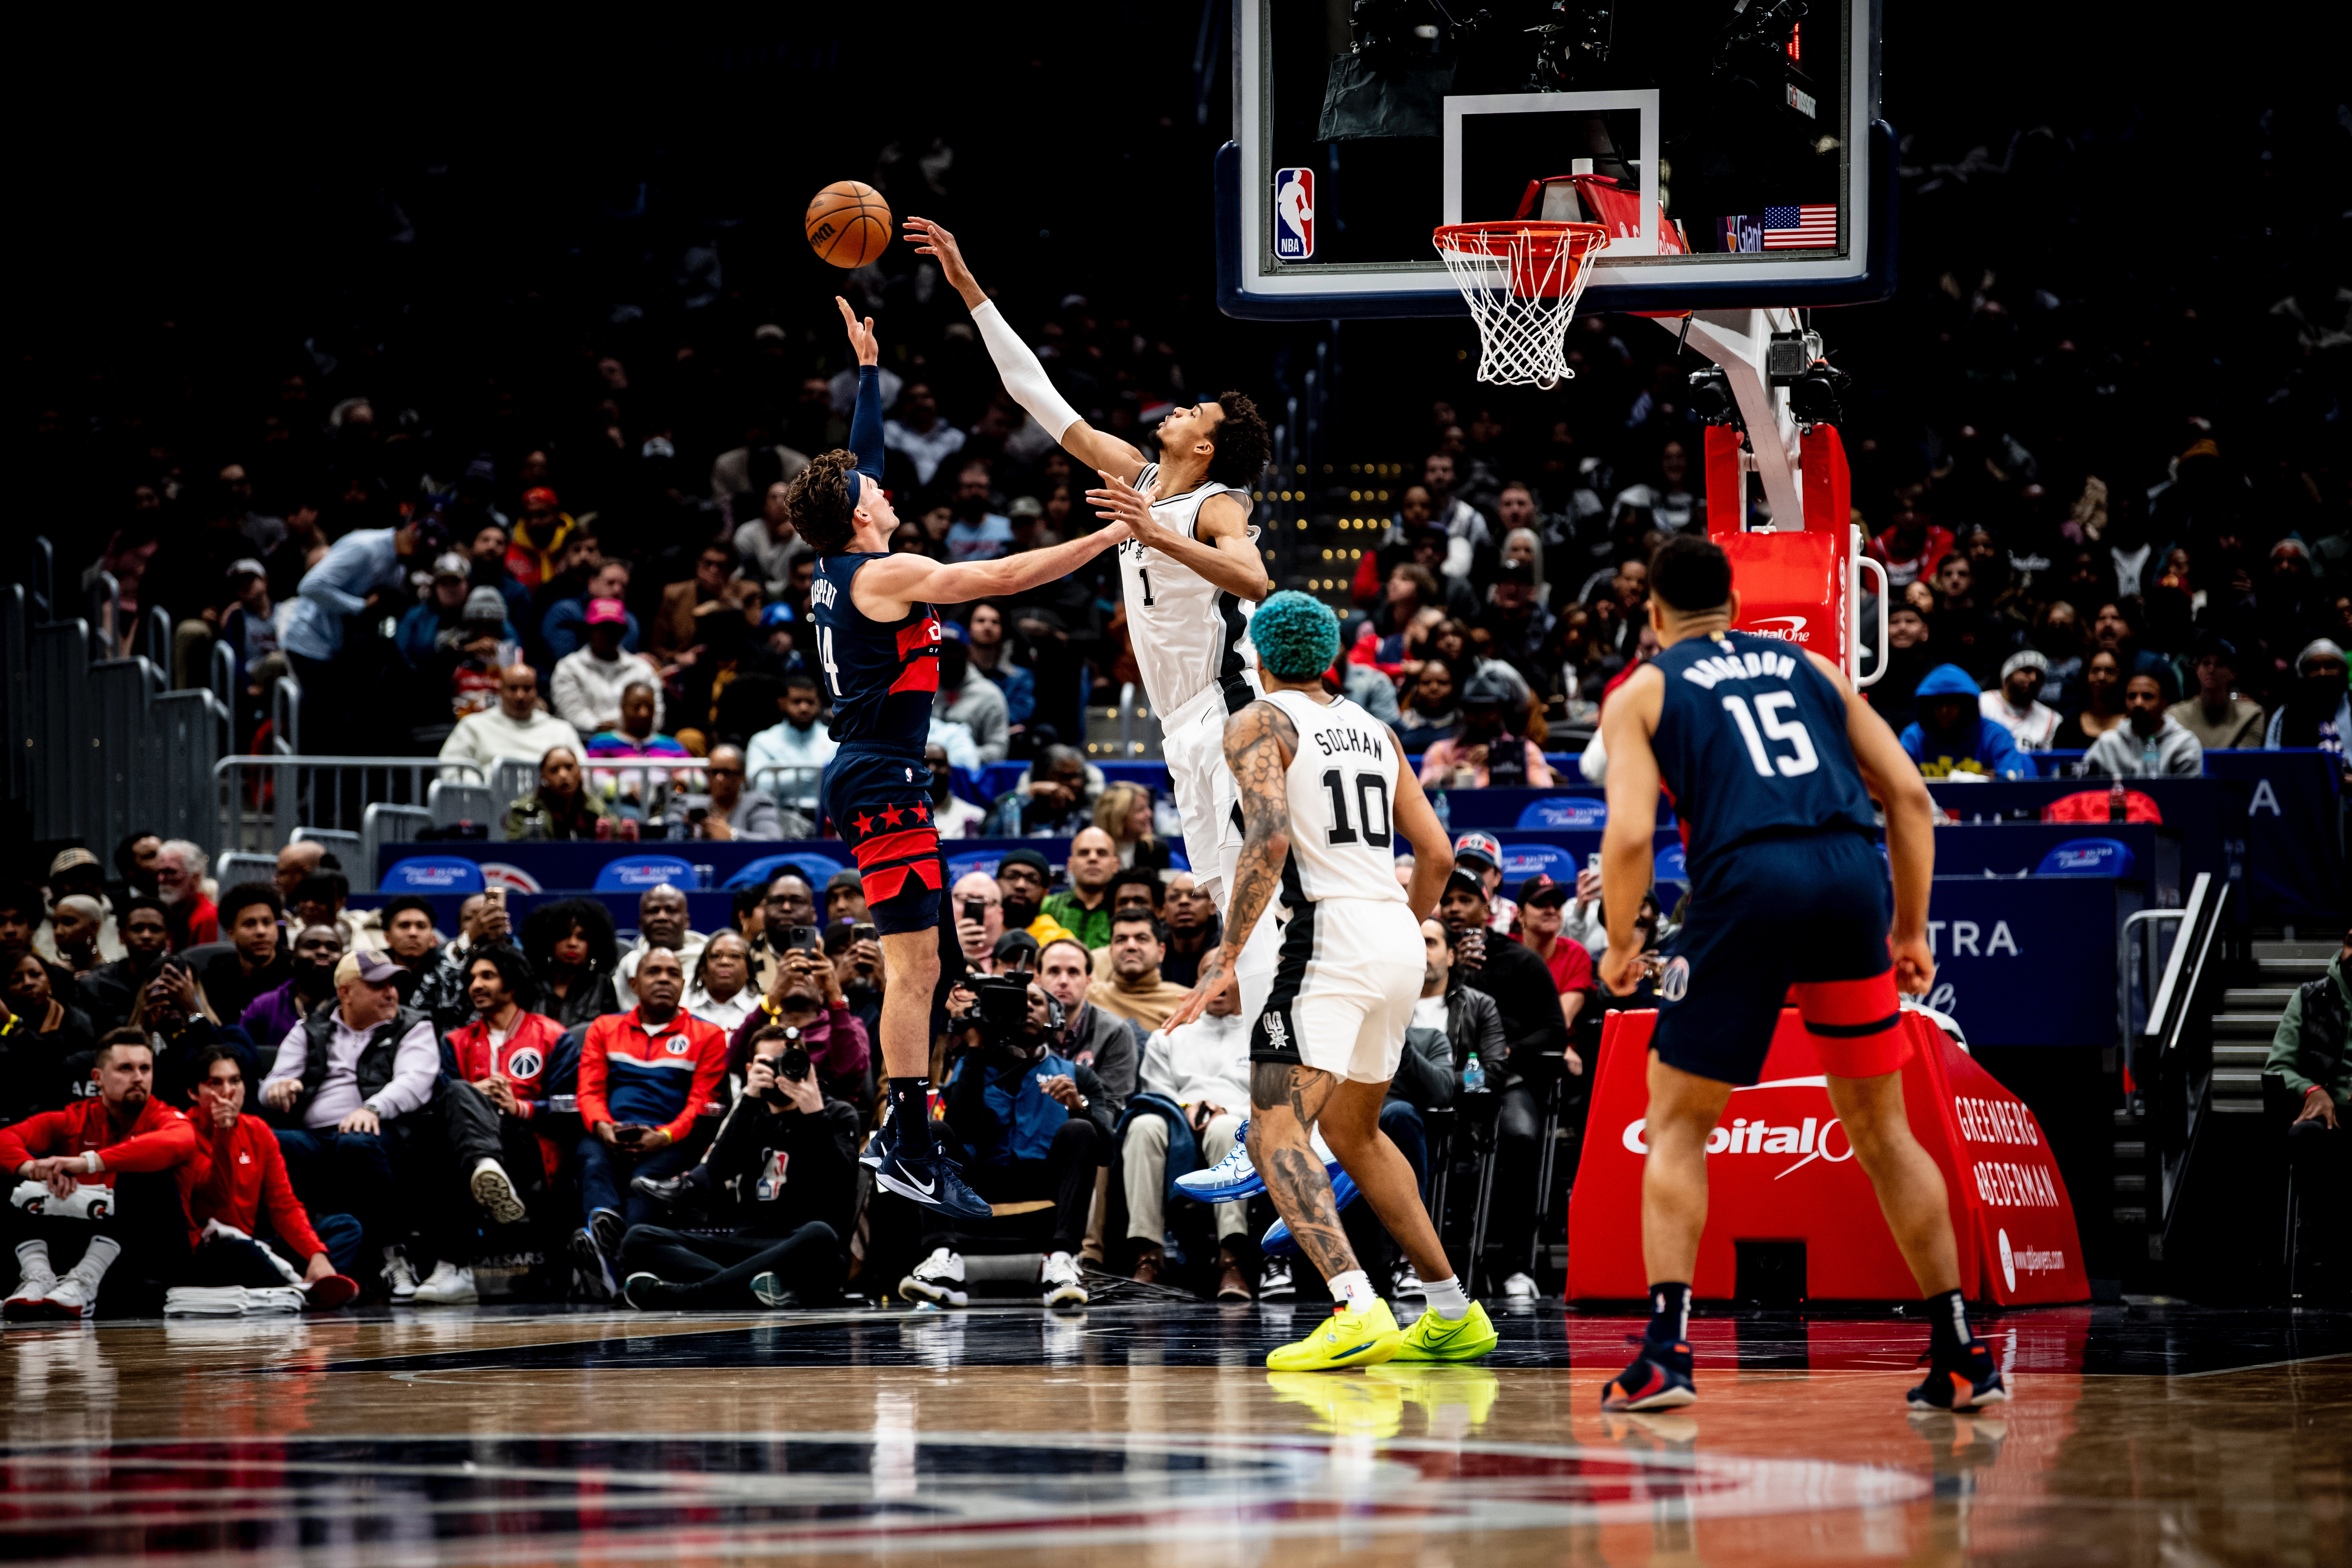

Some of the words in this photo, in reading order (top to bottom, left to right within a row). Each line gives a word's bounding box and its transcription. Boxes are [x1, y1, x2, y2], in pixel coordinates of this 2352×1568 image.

[1281, 238, 1299, 253] NBA
[1737, 215, 1762, 253] Giant
[1139, 566, 1155, 608] 1
[1682, 650, 1796, 690] BROGDON
[1315, 728, 1382, 761] SOCHAN
[1722, 690, 1819, 777] 15
[1321, 767, 1392, 849] 10
[1955, 1095, 2038, 1146] GREENBERG
[1978, 1161, 2059, 1207] BEDERMAN
